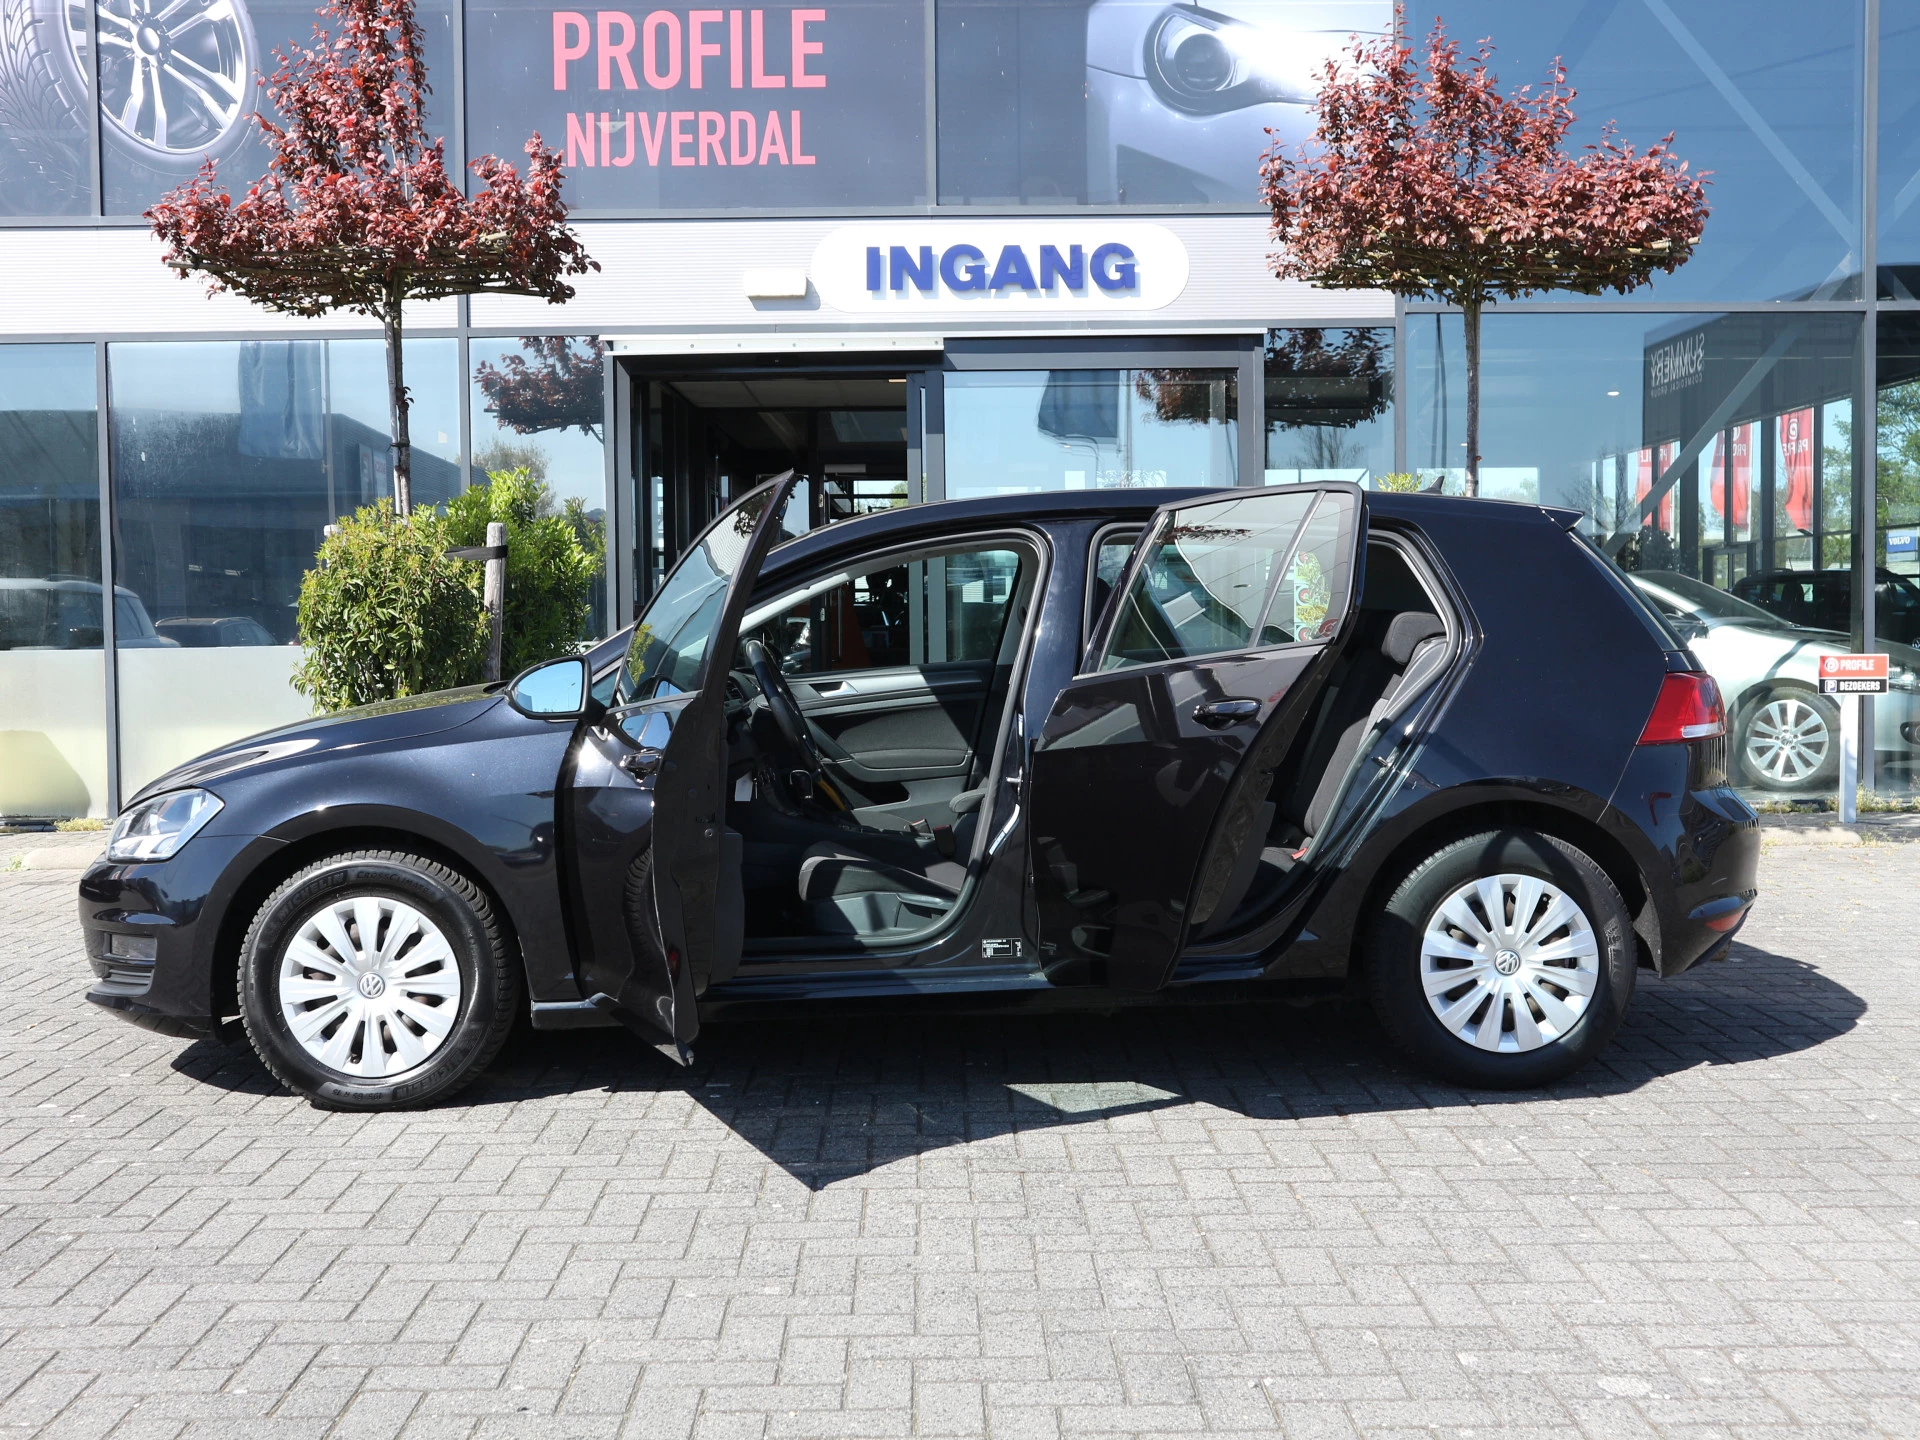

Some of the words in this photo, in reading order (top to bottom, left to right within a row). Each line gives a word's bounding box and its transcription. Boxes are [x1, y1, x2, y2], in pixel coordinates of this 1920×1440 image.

[553, 9, 827, 90] PROFILE
[566, 110, 816, 167] NIJVERDAL
[866, 243, 1136, 291] INGANG
[1889, 535, 1911, 546] VOLVO
[1840, 659, 1875, 671] PROFILE
[1839, 681, 1881, 691] BEZOEKERS
